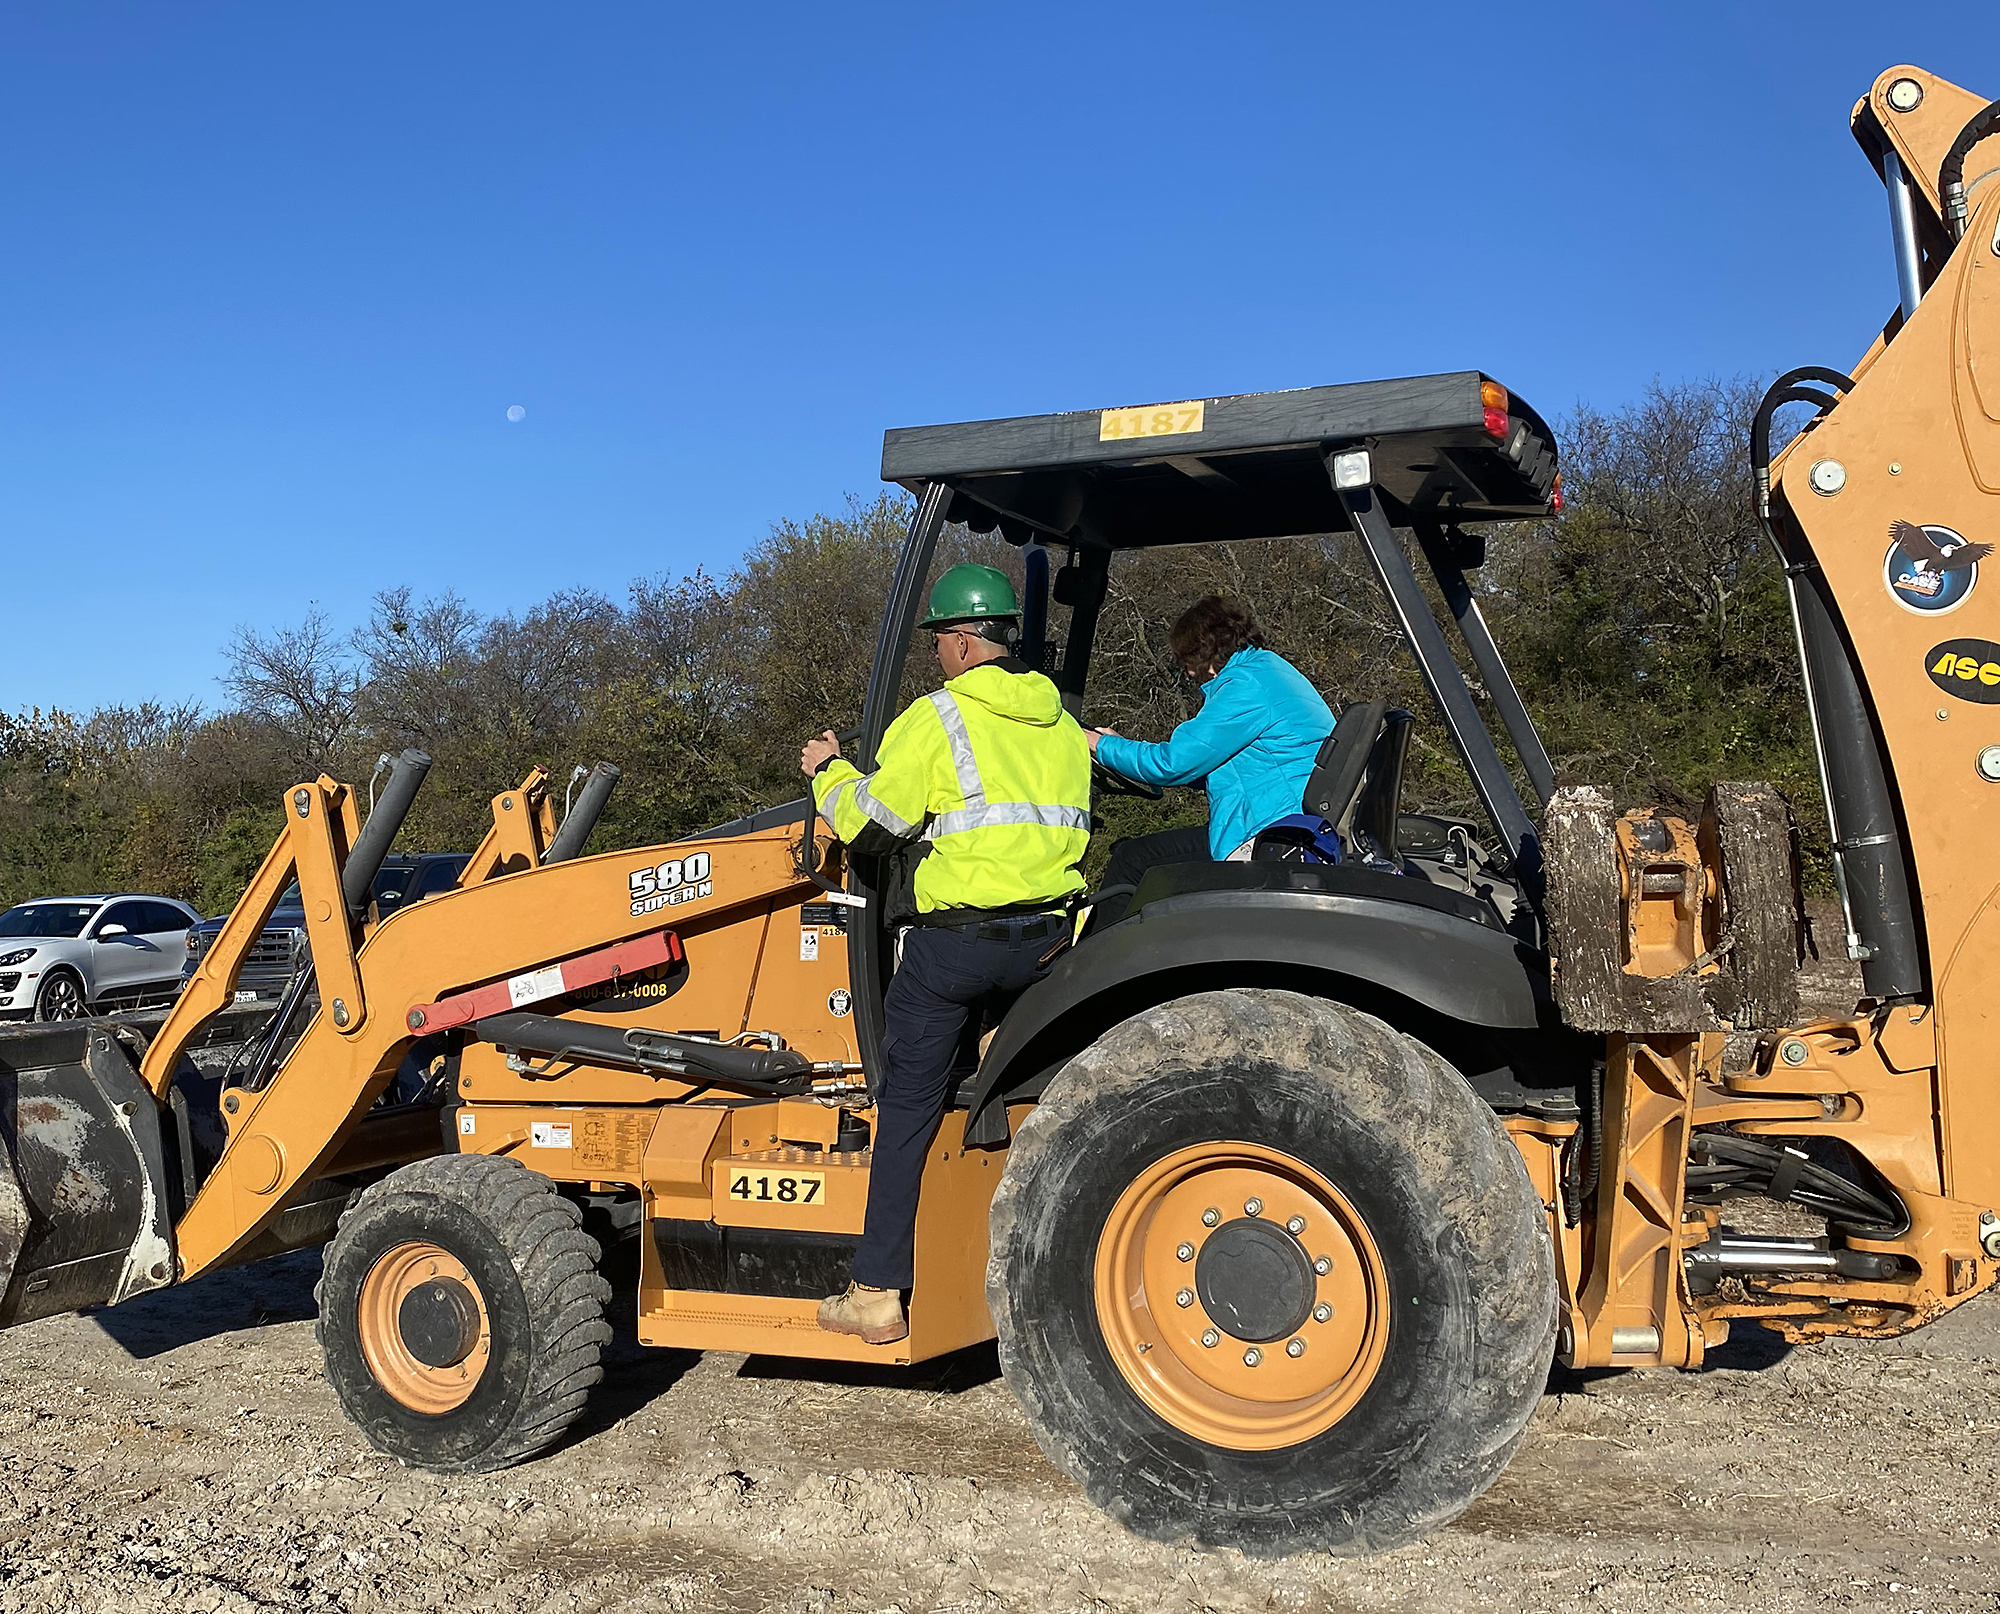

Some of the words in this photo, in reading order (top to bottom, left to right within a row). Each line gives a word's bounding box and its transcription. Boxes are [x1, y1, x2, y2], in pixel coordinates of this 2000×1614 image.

[1102, 409, 1200, 438] 4187
[1898, 573, 1940, 590] CASE
[629, 852, 711, 900] 580
[630, 886, 696, 916] SUPER
[697, 880, 713, 898] N
[731, 1176, 821, 1203] 4187
